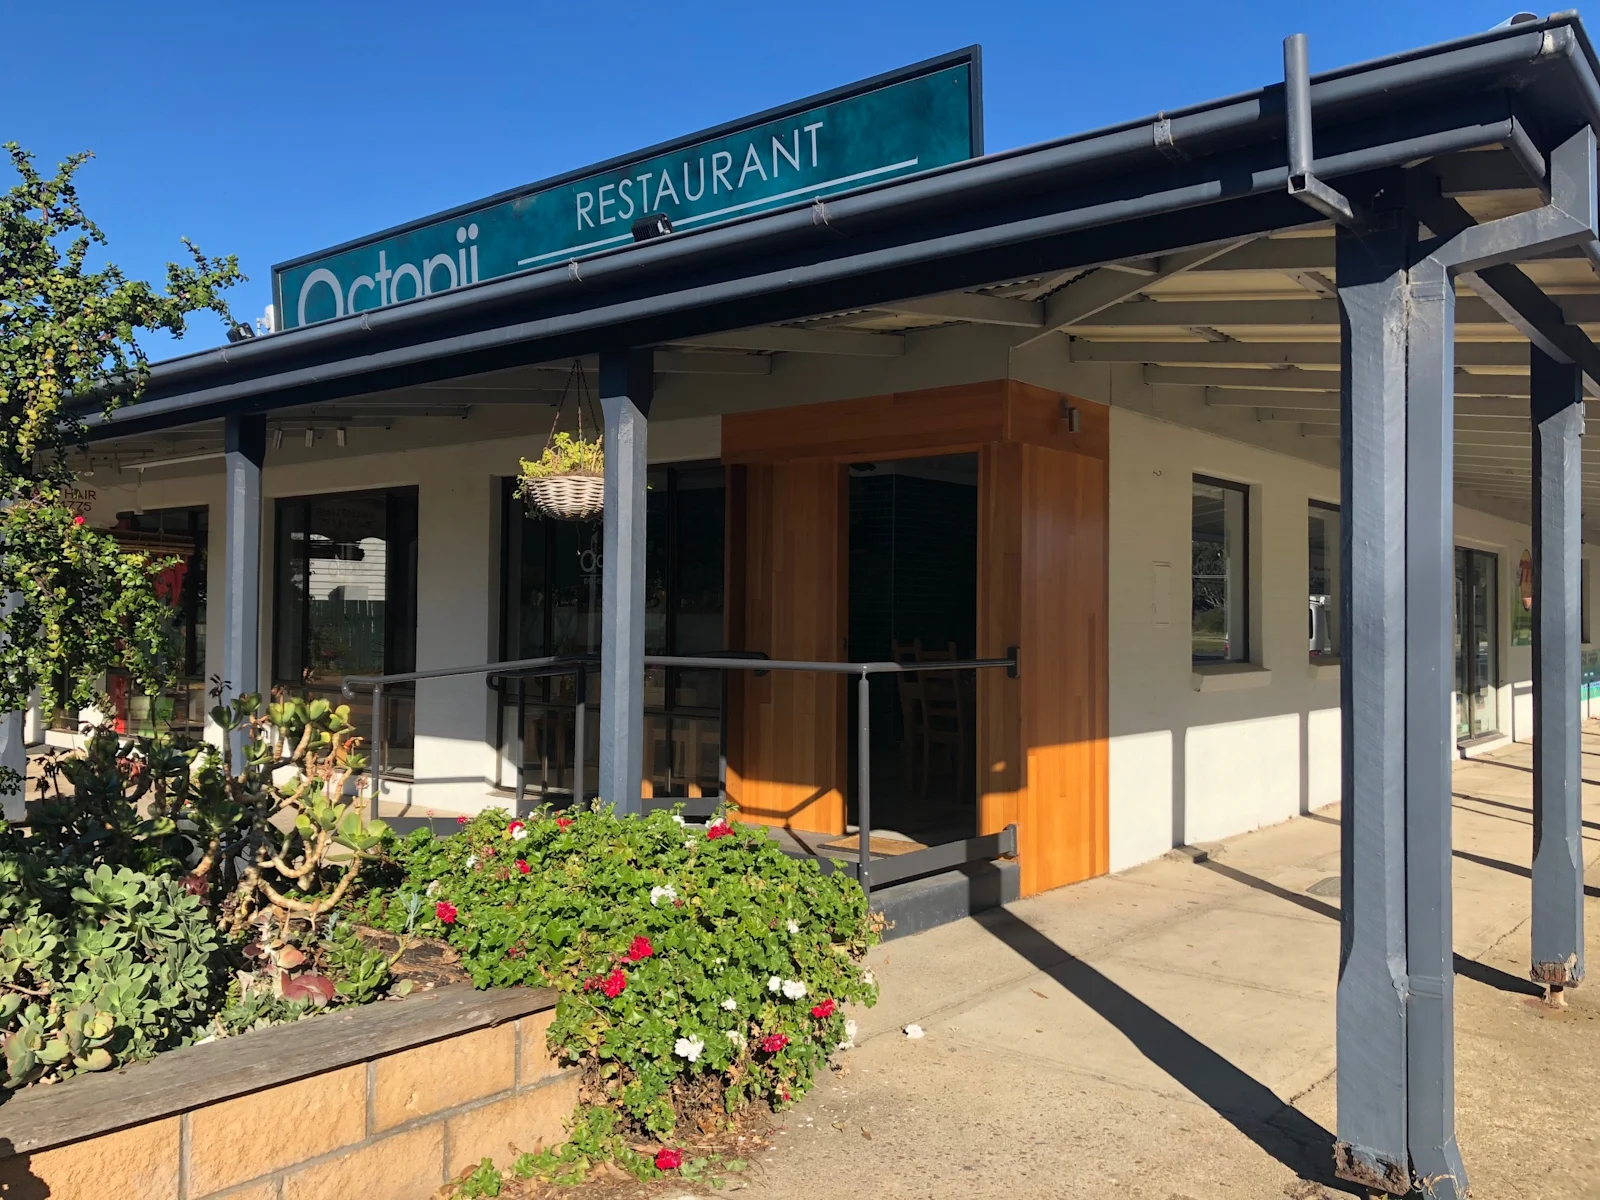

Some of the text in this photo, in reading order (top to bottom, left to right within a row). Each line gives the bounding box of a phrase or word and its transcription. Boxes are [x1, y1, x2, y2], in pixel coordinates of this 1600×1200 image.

[576, 122, 823, 231] RESTAURANT
[298, 223, 479, 327] Octopii
[64, 489, 97, 500] HAIR
